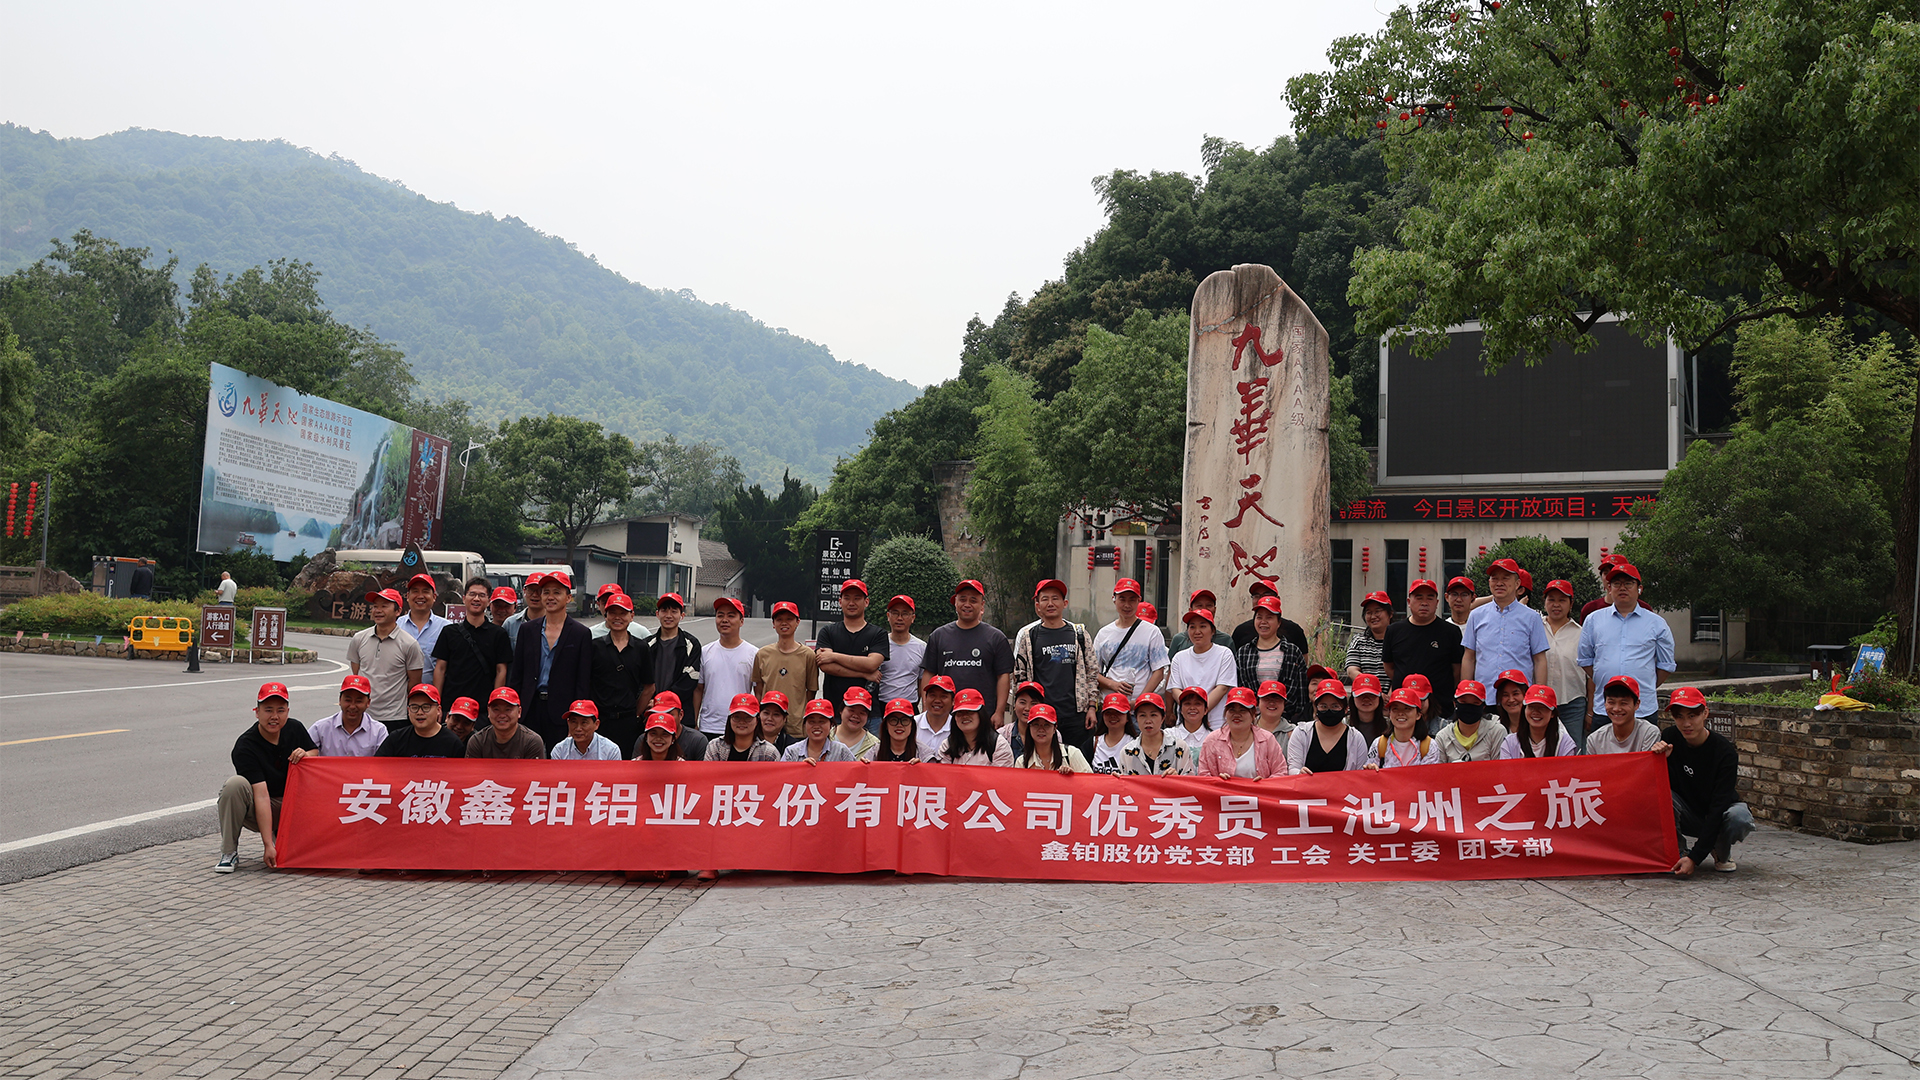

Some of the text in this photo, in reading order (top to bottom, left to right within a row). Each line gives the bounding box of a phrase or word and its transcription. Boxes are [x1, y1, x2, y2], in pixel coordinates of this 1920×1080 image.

[1290, 325, 1306, 428] 国家AAAA级
[301, 415, 352, 439] 国家AAAA级景区
[302, 403, 353, 427] 国家生态旅游示范区
[300, 428, 351, 452] 国家级水利风景区
[822, 550, 852, 559] 景区入口
[206, 612, 230, 621] 游客入口
[206, 621, 230, 631] 人行通道
[259, 613, 268, 639] 人行通道
[269, 614, 279, 639] 车行通道
[338, 777, 1607, 841] 安徽鑫铂铝业股份有限公司优秀员工池州之旅
[1040, 836, 1554, 867] 鑫铂股份党支部 工会 关工委 团支部
